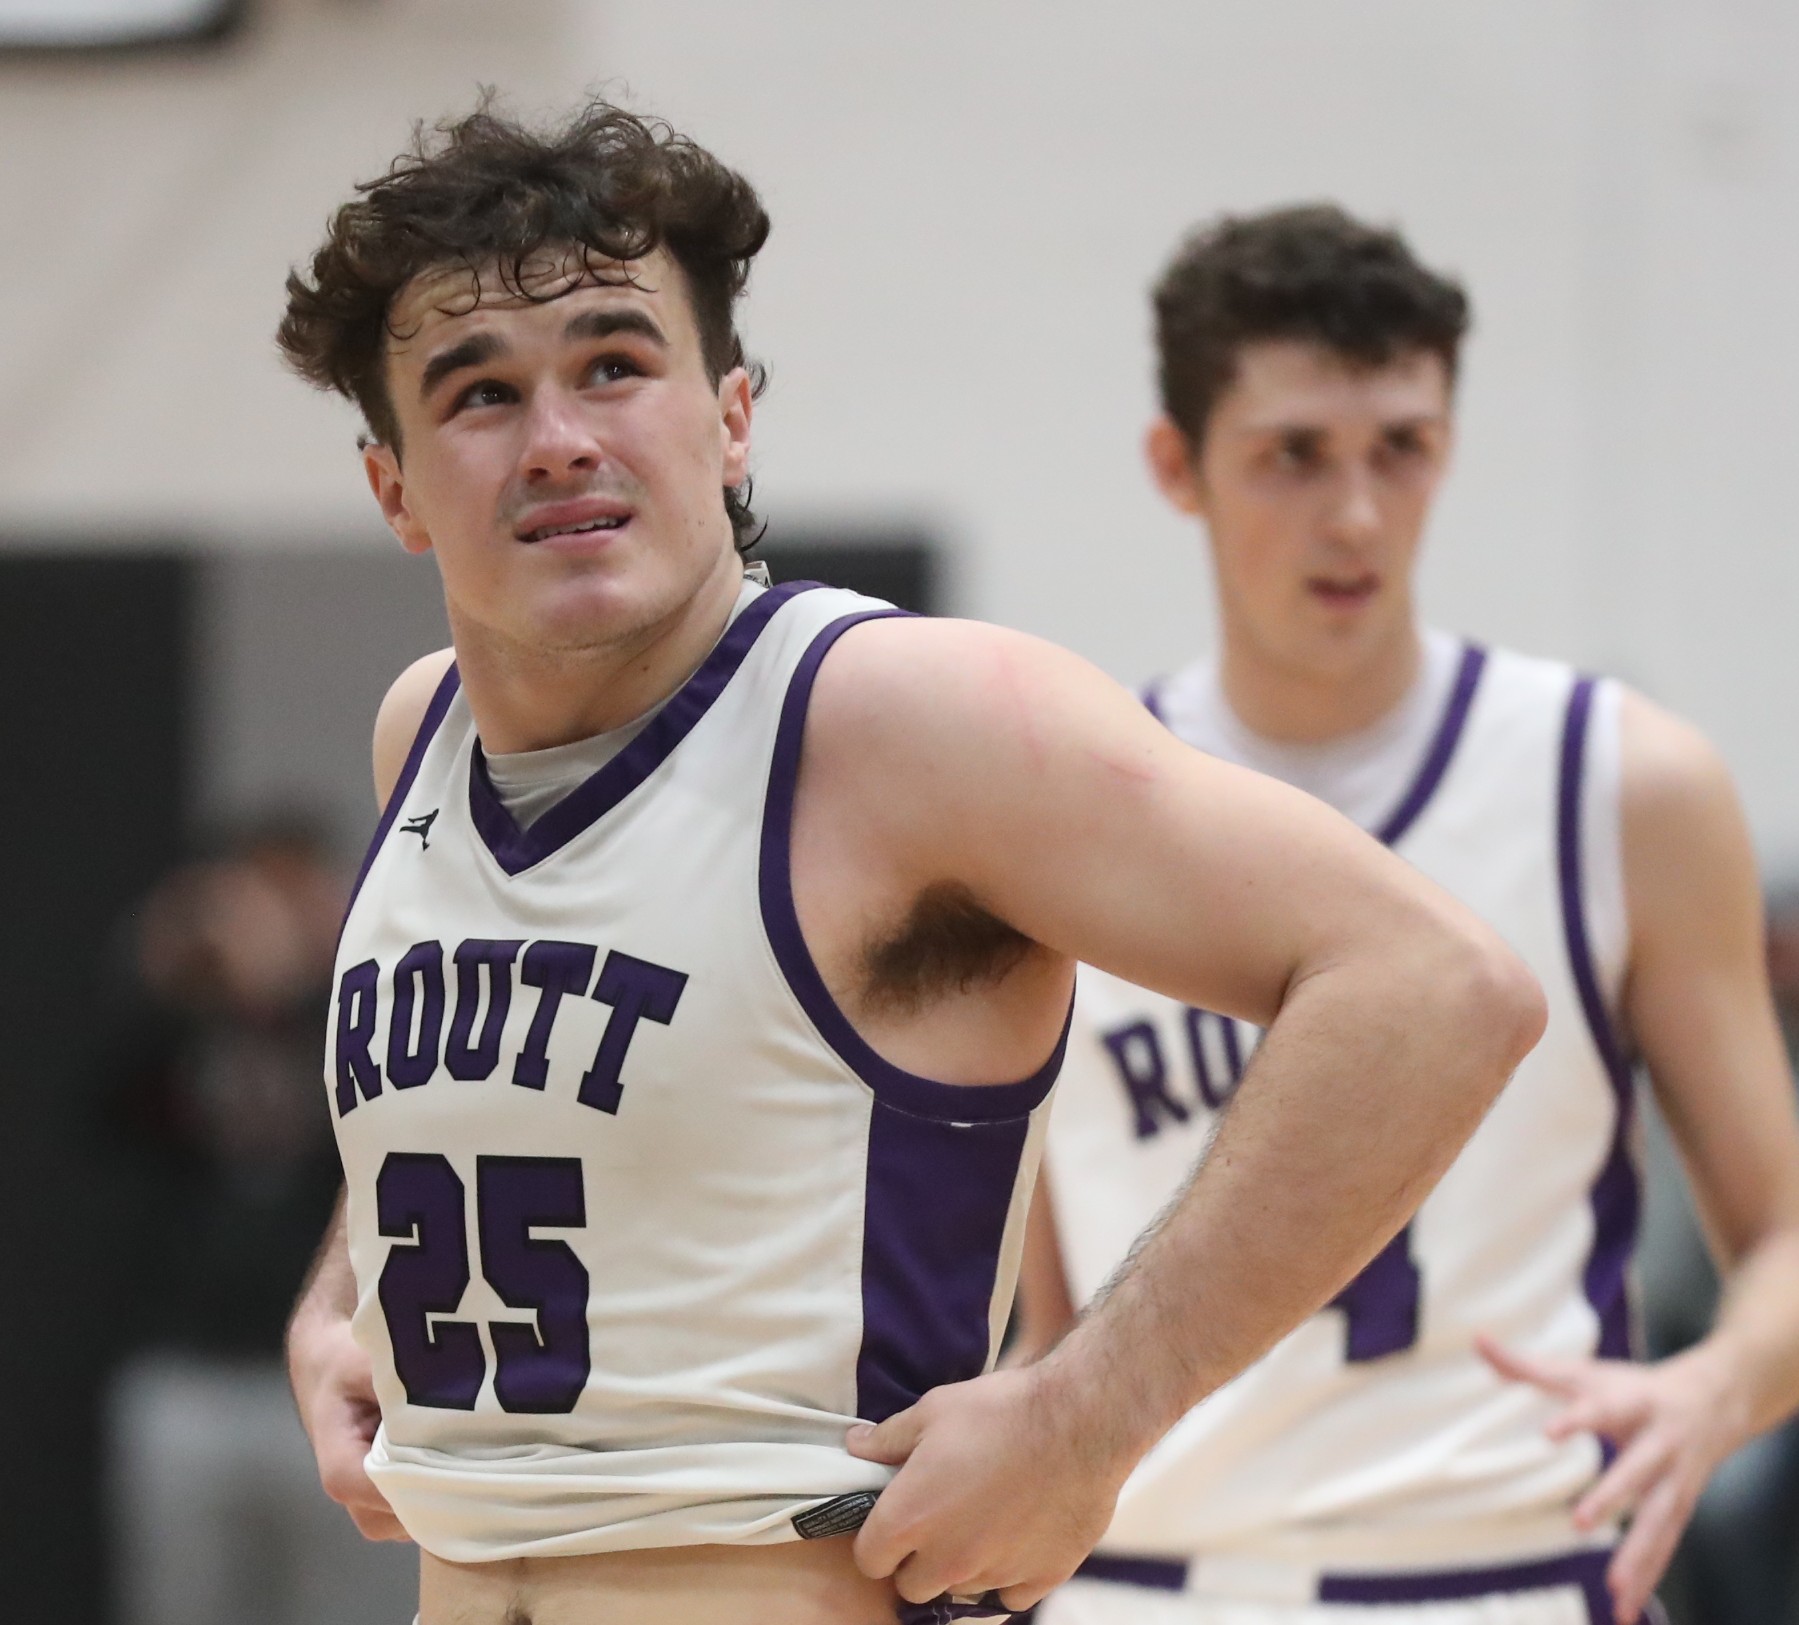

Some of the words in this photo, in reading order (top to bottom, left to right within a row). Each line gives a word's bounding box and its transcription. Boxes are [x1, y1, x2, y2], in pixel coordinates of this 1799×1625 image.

[335, 938, 689, 1119] ROUTT
[1098, 1006, 1242, 1141] RO
[376, 1151, 591, 1415] 25
